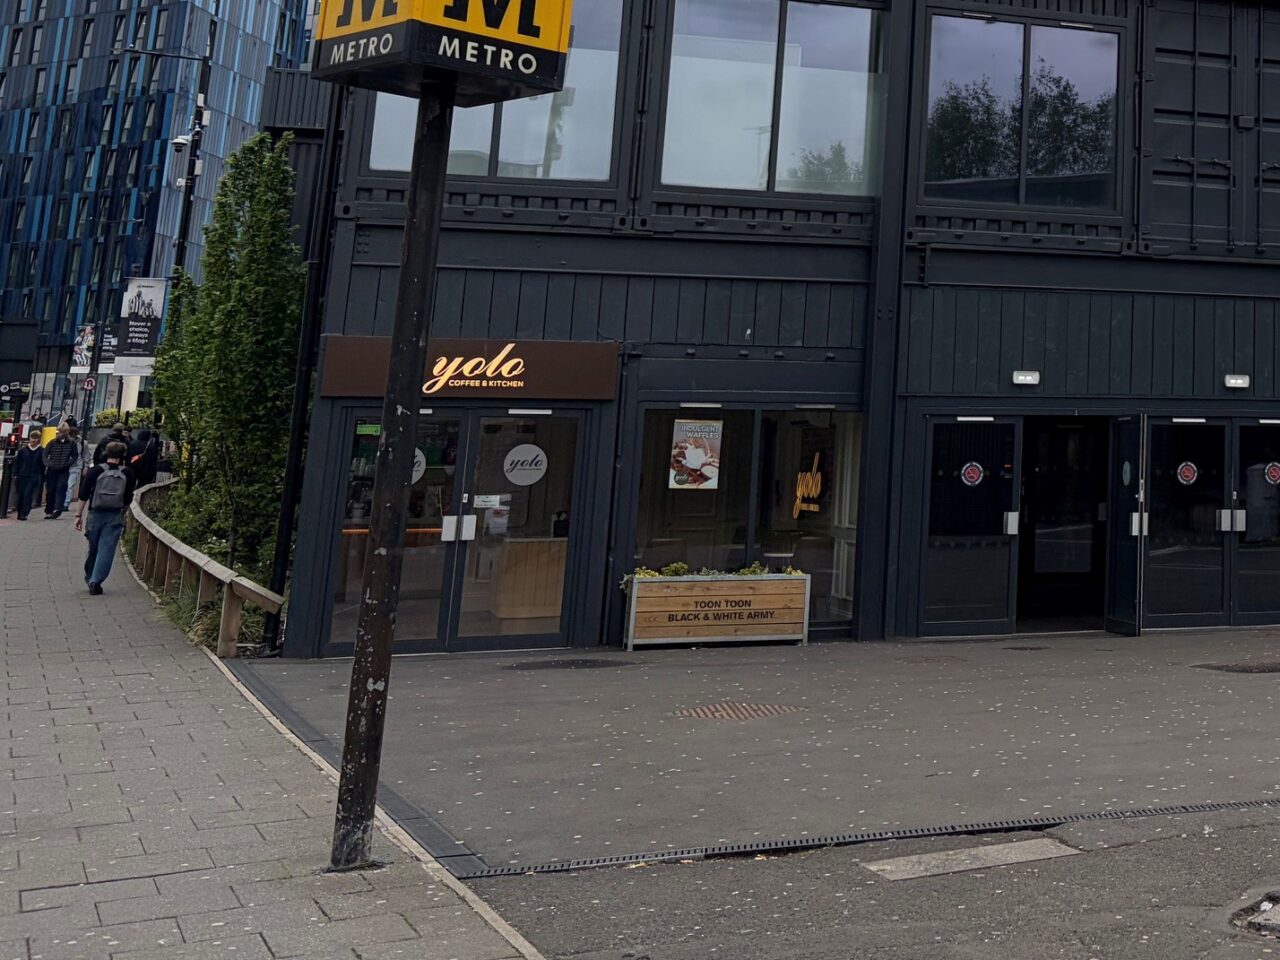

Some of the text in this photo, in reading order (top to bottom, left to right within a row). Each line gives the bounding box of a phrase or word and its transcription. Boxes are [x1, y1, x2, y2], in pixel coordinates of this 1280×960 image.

[330, 33, 394, 65] METRO
[438, 35, 538, 74] METRO
[422, 342, 526, 394] yolo
[448, 379, 524, 388] COFFEE & KITCHEN
[681, 424, 720, 433] INDULGENT
[686, 431, 719, 440] WAFFLES
[506, 453, 544, 474] yolo
[694, 599, 752, 609] TOON TOON
[667, 610, 776, 623] BLACK & WHITE ARMY
